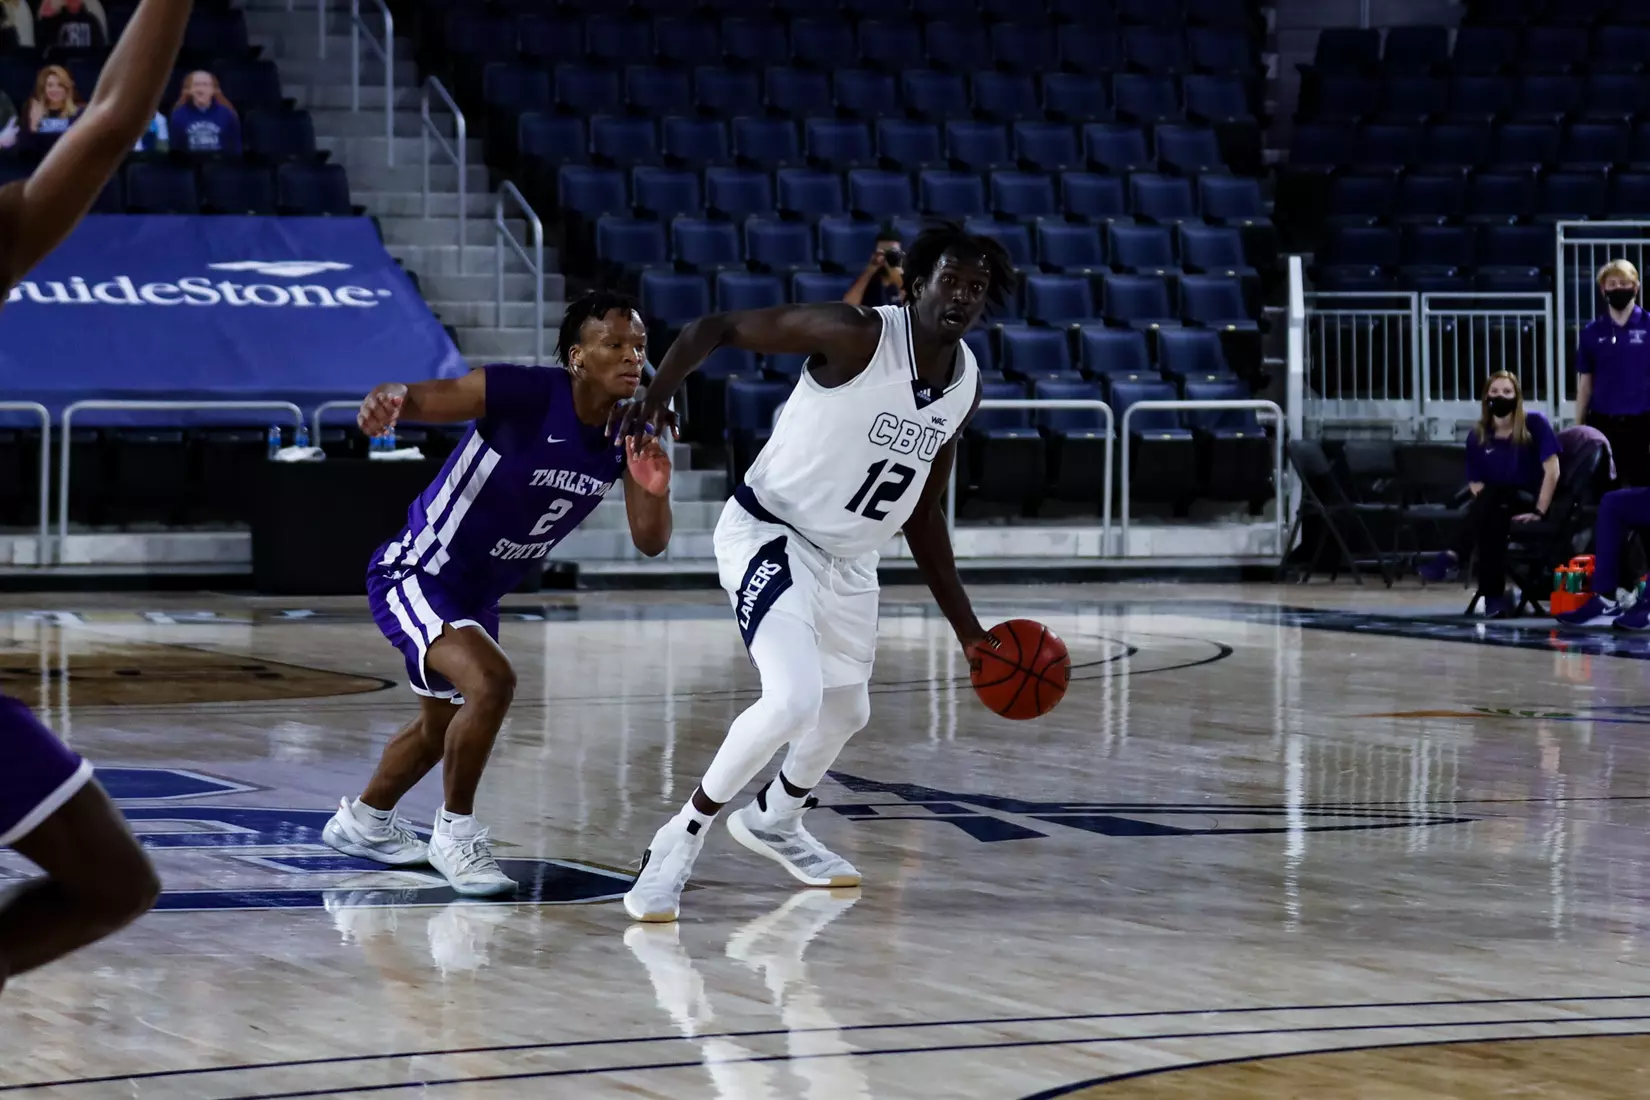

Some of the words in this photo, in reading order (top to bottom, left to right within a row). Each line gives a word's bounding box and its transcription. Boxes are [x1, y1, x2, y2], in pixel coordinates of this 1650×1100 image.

[8, 275, 380, 308] uideStone
[868, 411, 946, 463] CBU
[931, 415, 948, 426] WAC
[844, 458, 916, 521] 12
[528, 498, 574, 536] 2
[489, 537, 556, 560] STATE
[740, 559, 783, 631] LANCERS
